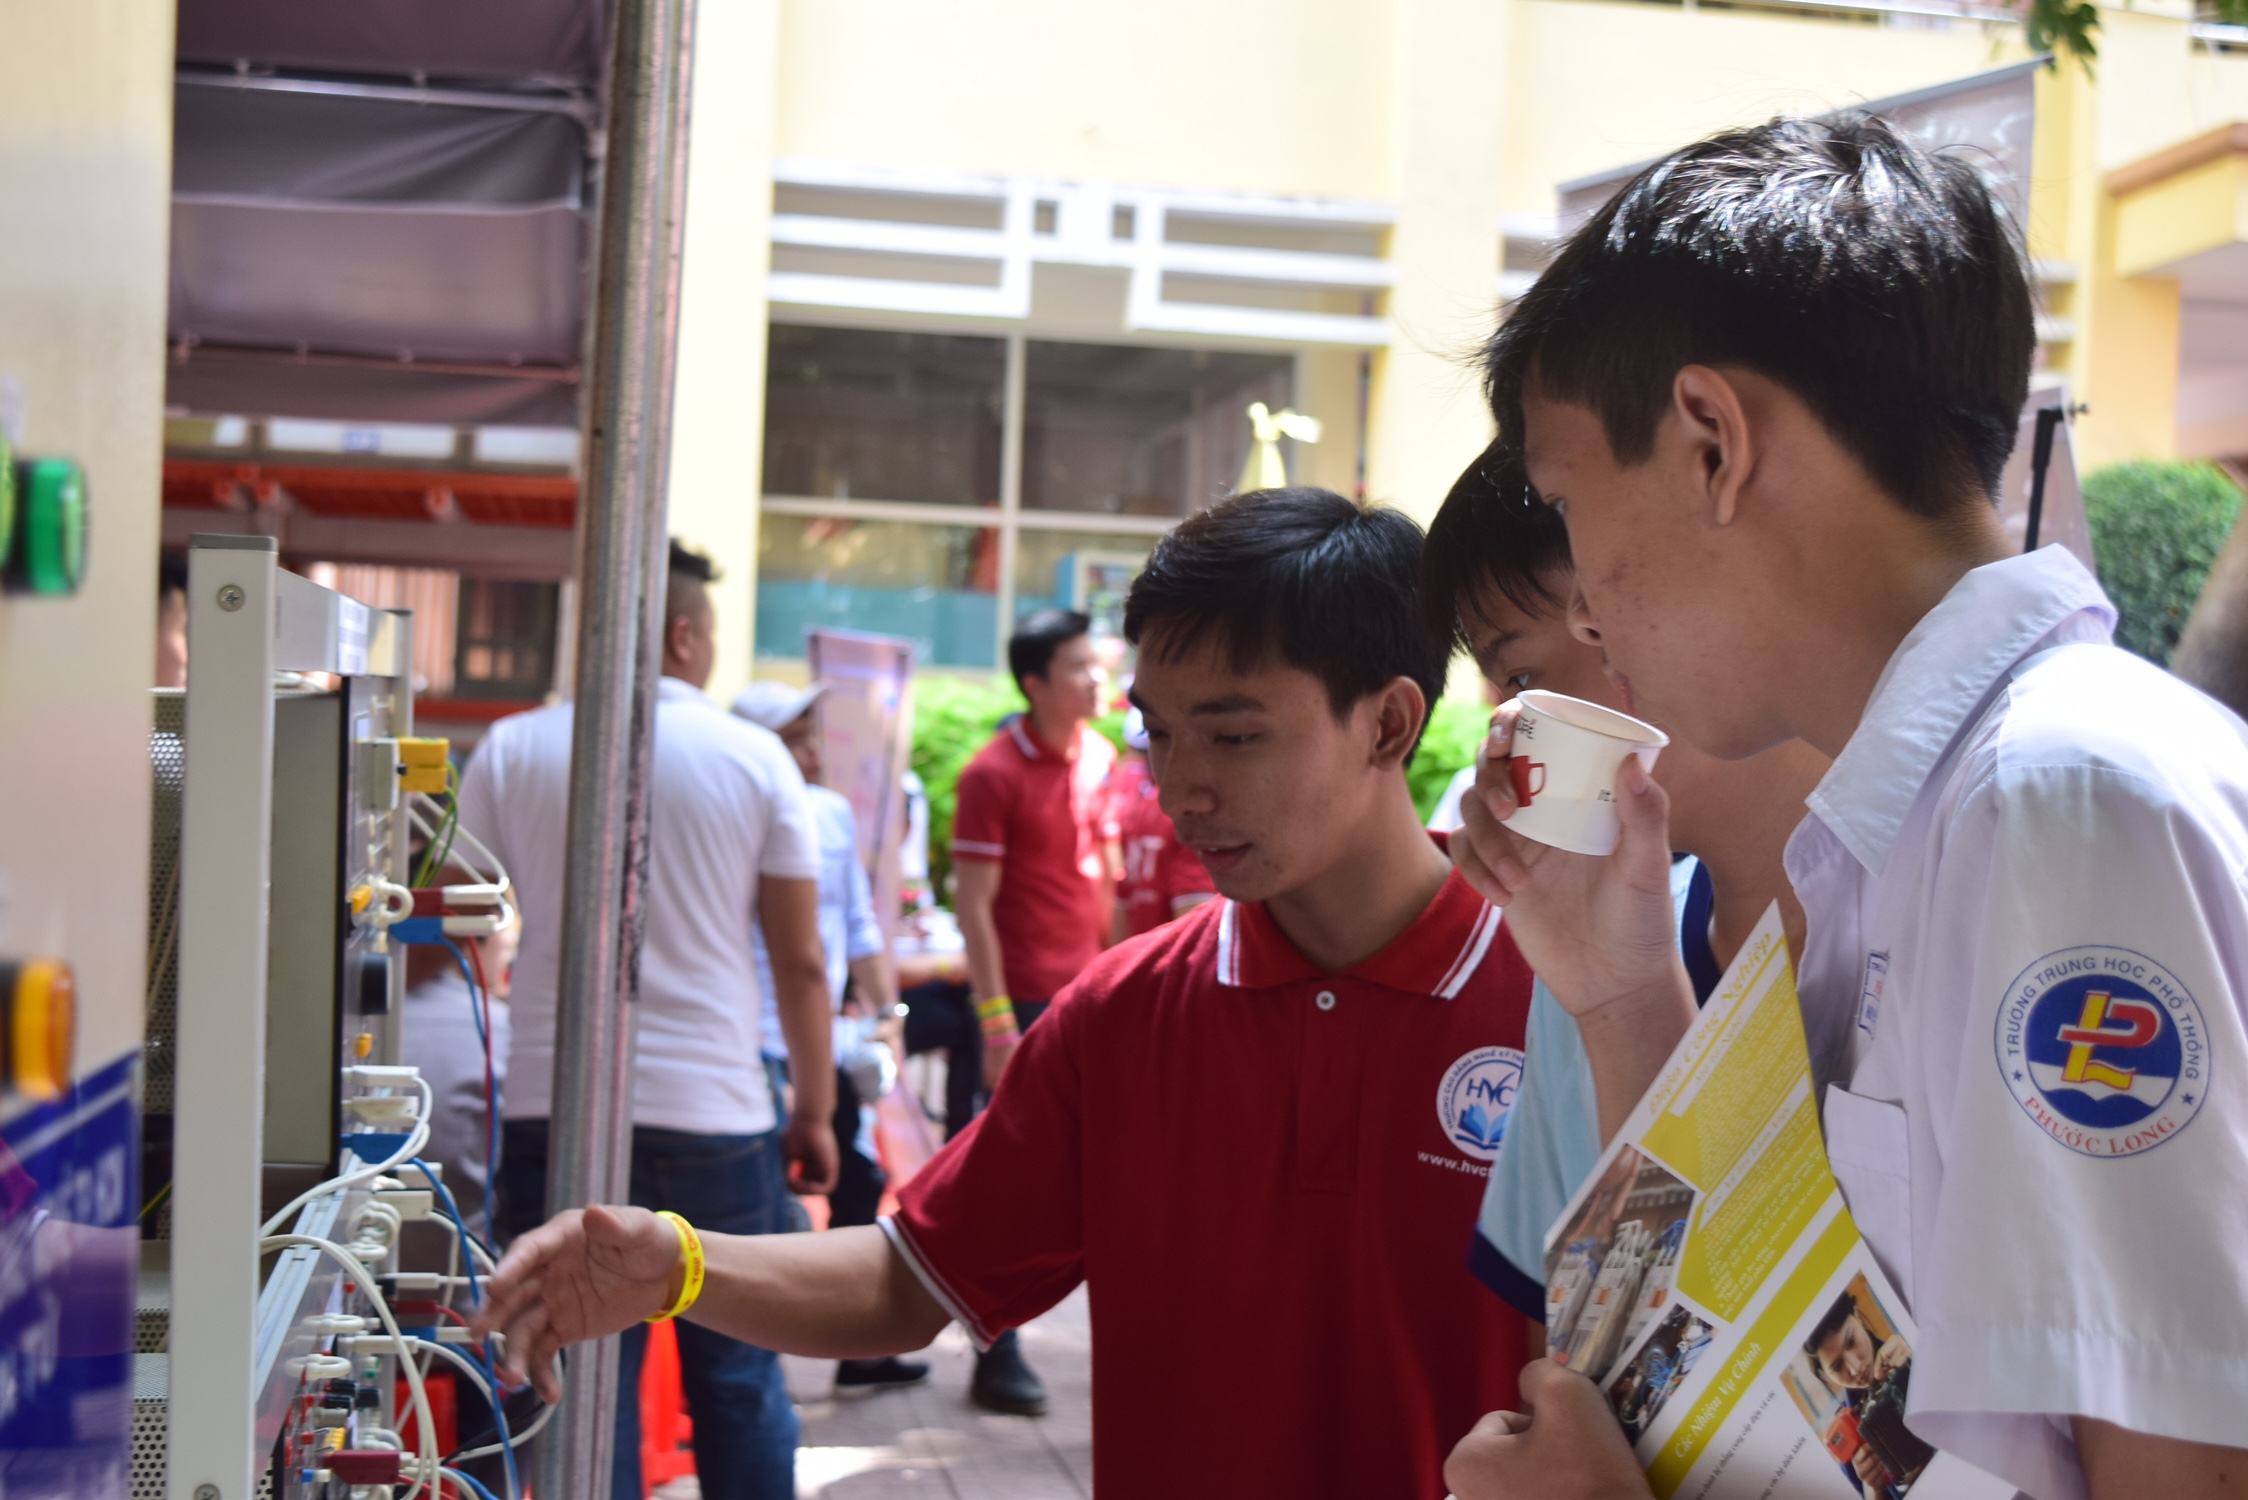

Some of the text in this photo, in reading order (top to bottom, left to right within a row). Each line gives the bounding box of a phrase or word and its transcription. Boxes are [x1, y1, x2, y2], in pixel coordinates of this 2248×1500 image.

[2034, 957, 2097, 986] TRUNG
[2180, 1013, 2203, 1080] THÔNG
[1466, 1071, 1516, 1107] HVC
[2025, 1096, 2177, 1154] PHƯỚC LONG
[1691, 1397, 1722, 1435] Nhiệm
[1733, 1342, 1761, 1379] Chính
